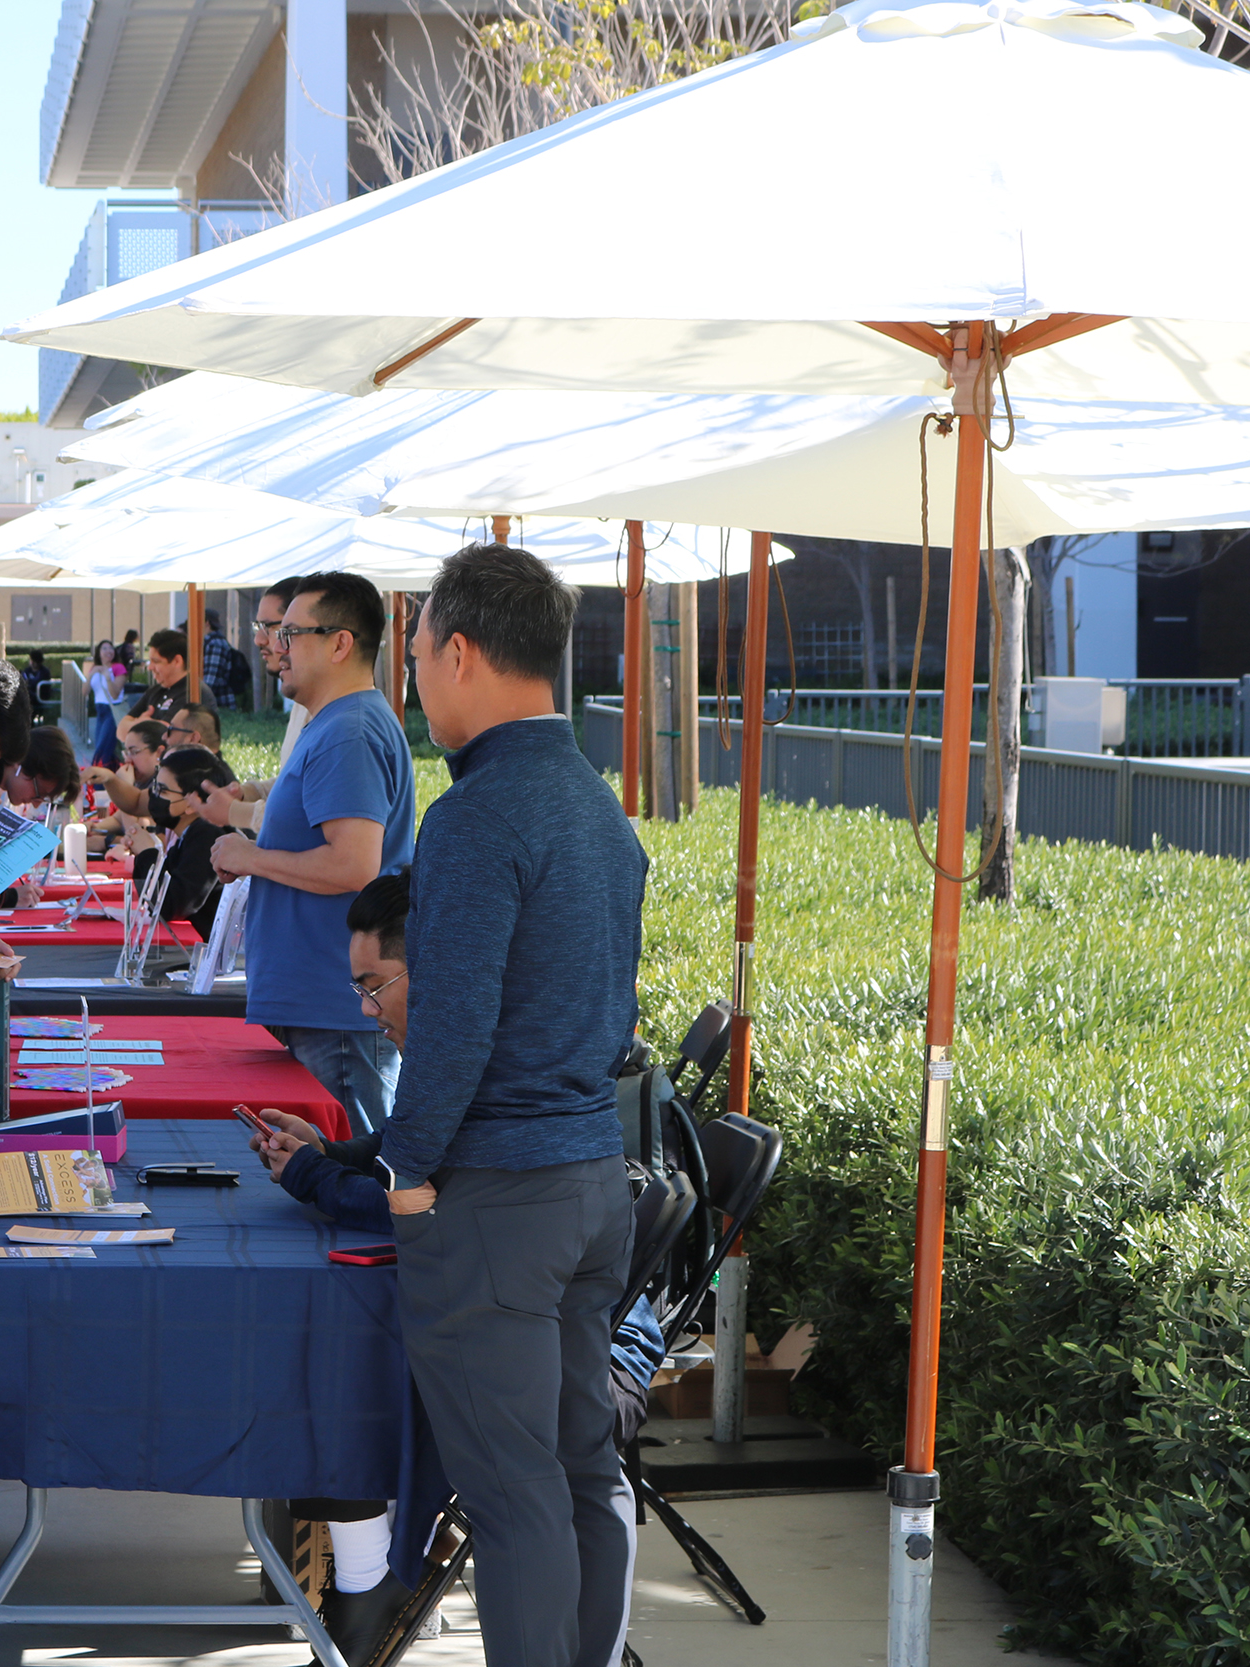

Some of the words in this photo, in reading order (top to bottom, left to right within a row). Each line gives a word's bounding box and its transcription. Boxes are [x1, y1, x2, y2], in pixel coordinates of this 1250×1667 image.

[28, 1153, 39, 1177] $12/year
[44, 1159, 52, 1173] Solid
[54, 1153, 76, 1203] EXCESS
[47, 1174, 60, 1205] Connection
